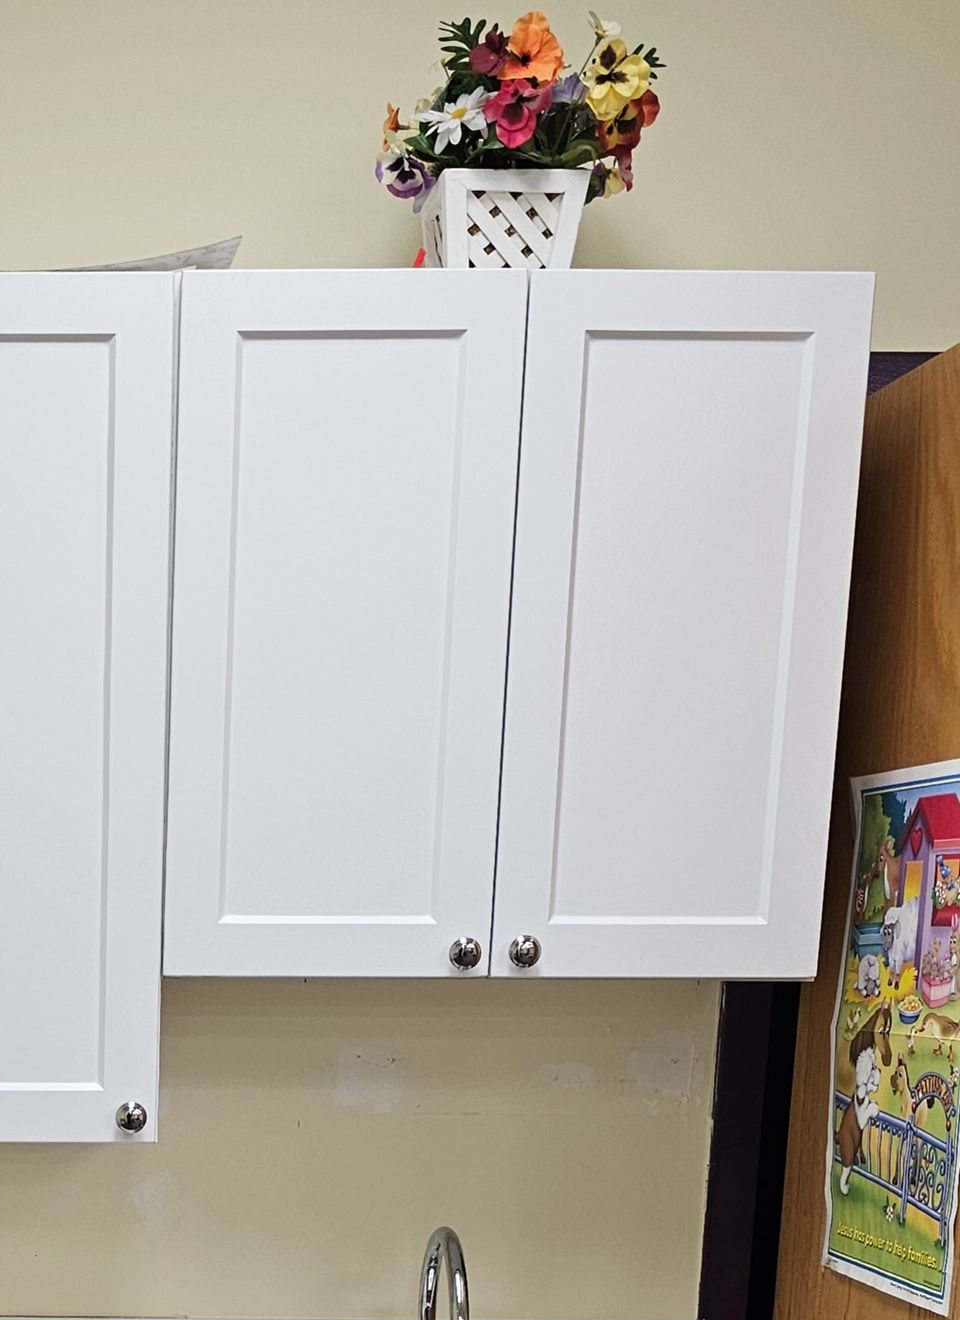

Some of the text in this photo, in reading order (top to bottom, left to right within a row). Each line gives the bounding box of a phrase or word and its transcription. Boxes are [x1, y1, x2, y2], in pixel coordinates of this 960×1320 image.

[837, 1222, 938, 1270] Jesus has power to help families.
